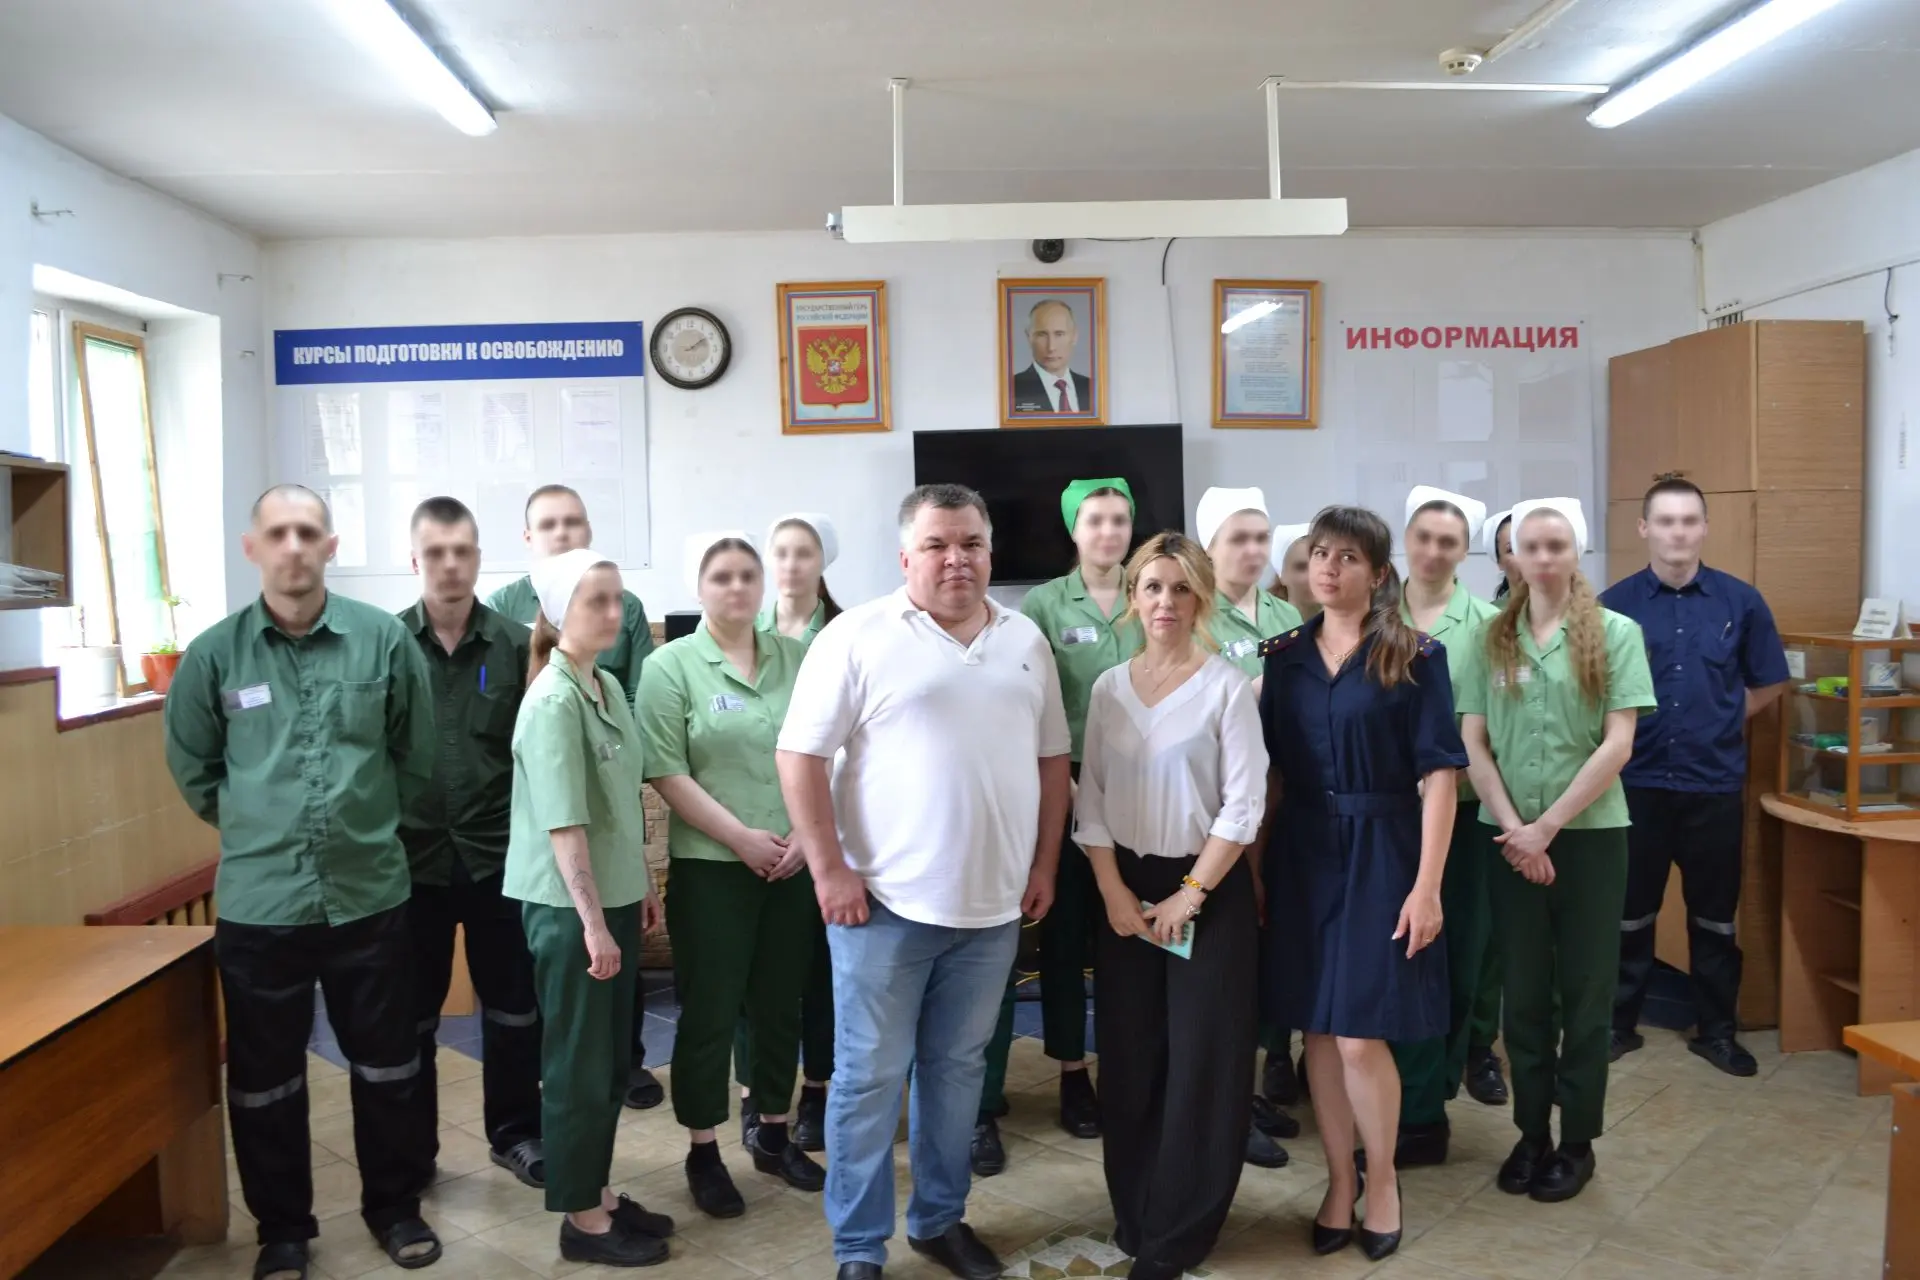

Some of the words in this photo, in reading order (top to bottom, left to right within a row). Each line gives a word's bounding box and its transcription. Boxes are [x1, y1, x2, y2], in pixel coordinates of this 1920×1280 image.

[292, 345, 352, 365] КУРСЫ
[354, 342, 463, 365] ПОДГОТОВКИ
[465, 342, 478, 360] К
[480, 339, 624, 361] ОСВОБОЖДЕНИЮ
[1346, 326, 1579, 352] ИНФОРМАЦИЯ
